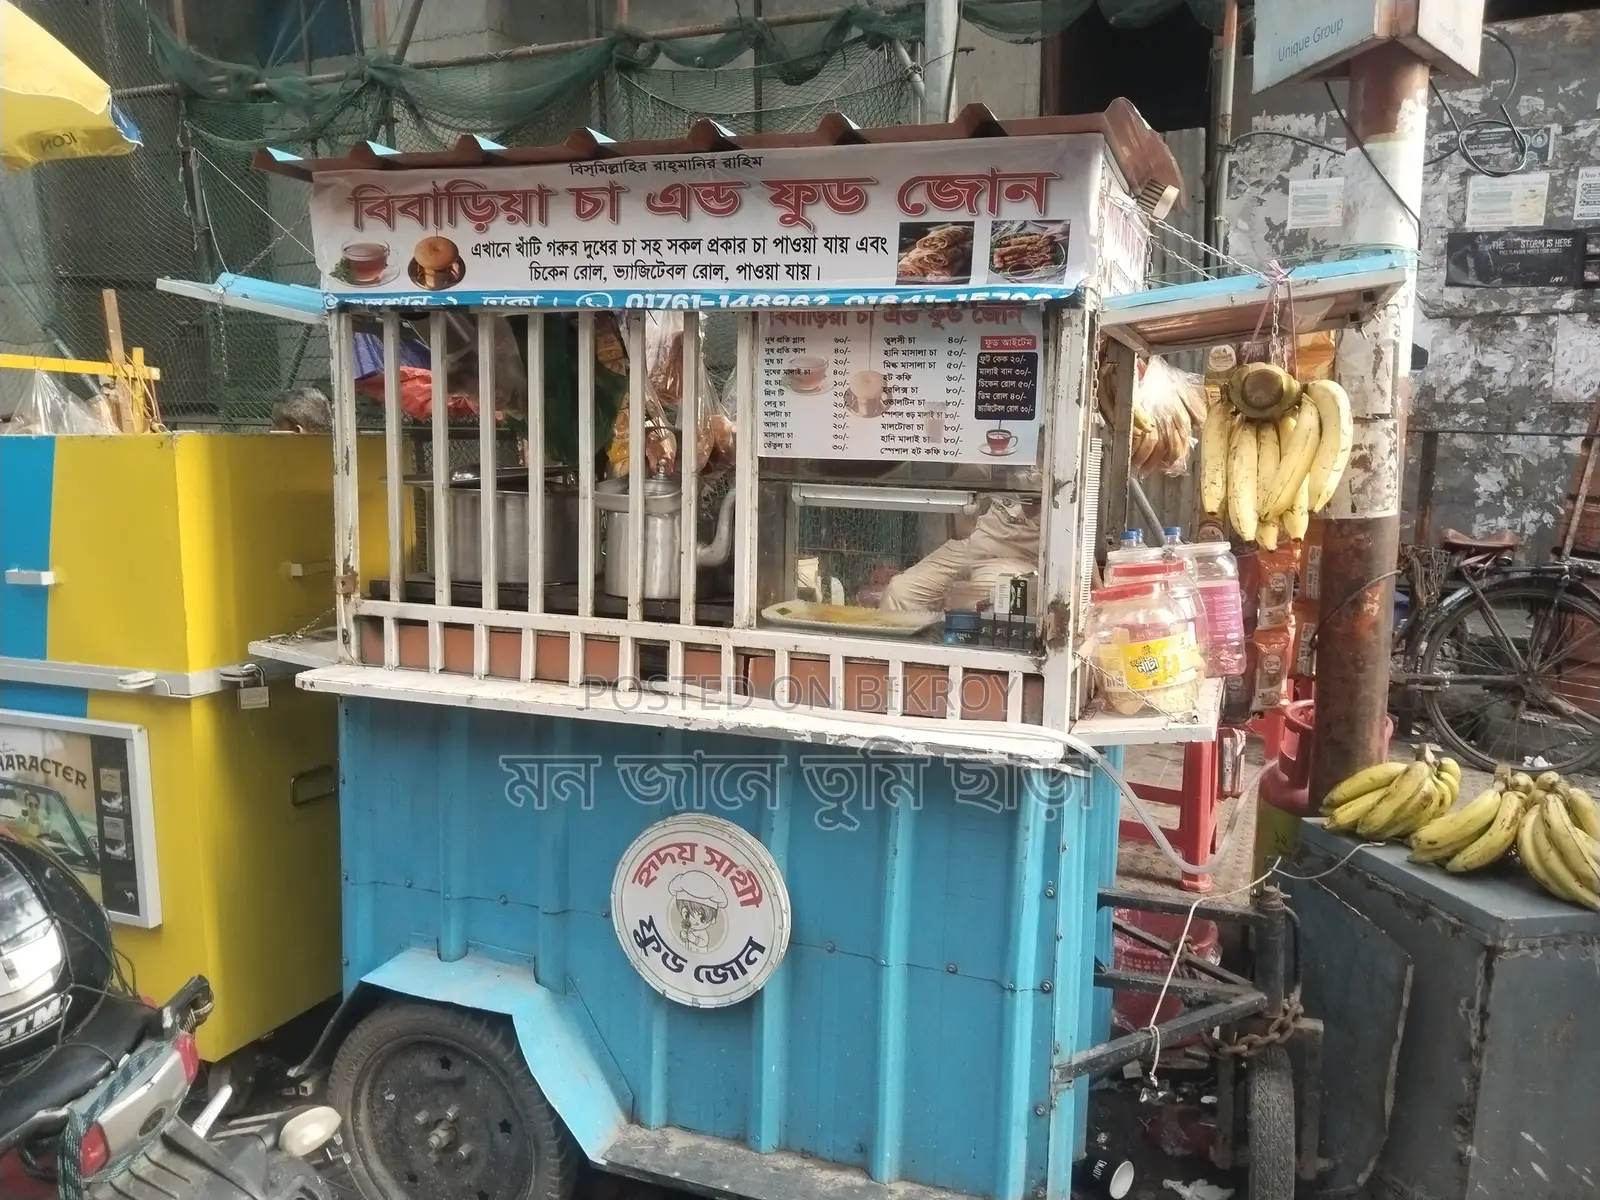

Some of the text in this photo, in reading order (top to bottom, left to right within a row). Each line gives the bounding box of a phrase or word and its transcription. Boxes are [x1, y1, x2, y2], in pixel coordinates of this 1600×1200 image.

[1278, 17, 1344, 62] Unique Group
[722, 154, 764, 169] রাহিম
[346, 166, 1060, 233] বিবাড়িয়া চা এন্ড ফুড জোন
[471, 235, 889, 260] এখানে খাঁটি গরুর দুধের চা সহ সকল প্রকার চা পাওয়া যায় এবং
[1520, 238, 1545, 249] STORM
[1545, 238, 1553, 248] IS
[1554, 238, 1572, 248] HERE
[529, 261, 569, 282] চিকেন
[574, 263, 607, 283] রোল,
[612, 259, 688, 281] ভ্যাজিটেবল
[692, 262, 729, 283] রোল,
[736, 262, 780, 281] পাওয়া
[884, 335, 906, 345] তুলসী
[947, 336, 967, 344] ৪০/-
[984, 337, 1033, 349] ফুড আইটেম
[834, 347, 851, 355] ৪০/-
[883, 347, 899, 357] হানি
[901, 348, 927, 356] মাসালা
[947, 348, 966, 357] ৫০/-
[834, 358, 850, 366] ২০/-
[900, 361, 926, 369] মাসালা
[928, 361, 936, 369] চা
[946, 361, 966, 370] ৫০/-
[896, 372, 912, 381] কফি
[945, 373, 965, 383] ৬০/-
[1017, 380, 1035, 389] ৫০/-
[945, 386, 965, 395] ৮০/-
[1010, 392, 1027, 401] ৪০/-
[945, 399, 964, 408] ৮০/-
[936, 411, 943, 419] চা
[945, 412, 960, 420] ৮০/-
[944, 424, 963, 432] ৮০/-
[880, 433, 896, 443] হানি
[898, 434, 921, 444] মালাই
[943, 436, 963, 445] ৮০/-
[911, 446, 922, 456] হট
[924, 447, 941, 456] কফি
[942, 448, 963, 457] ৮০/-
[0, 754, 88, 789] ARACTER
[704, 845, 763, 908] সাথী
[633, 915, 766, 984] ফুড জোন
[1093, 1160, 1107, 1180] ENJOY
